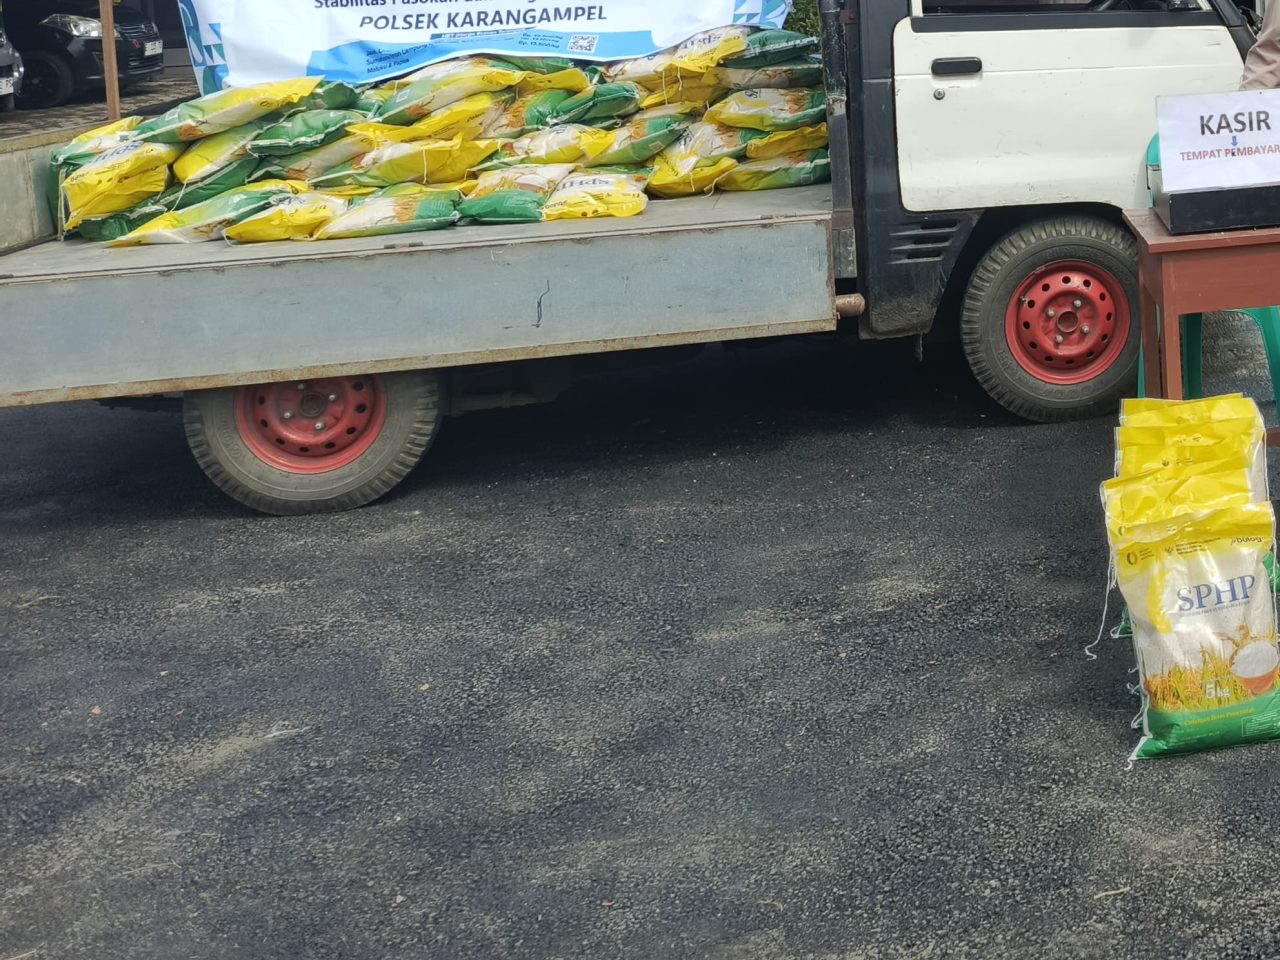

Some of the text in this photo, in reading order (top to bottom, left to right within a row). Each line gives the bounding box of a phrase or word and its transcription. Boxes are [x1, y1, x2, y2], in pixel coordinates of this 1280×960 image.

[360, 6, 608, 31] POLSEK KARANGAMPEL
[1200, 110, 1271, 136] KASIR
[1180, 149, 1223, 161] TEMPAT
[1176, 575, 1255, 611] SPHP
[1206, 680, 1216, 699] 5
